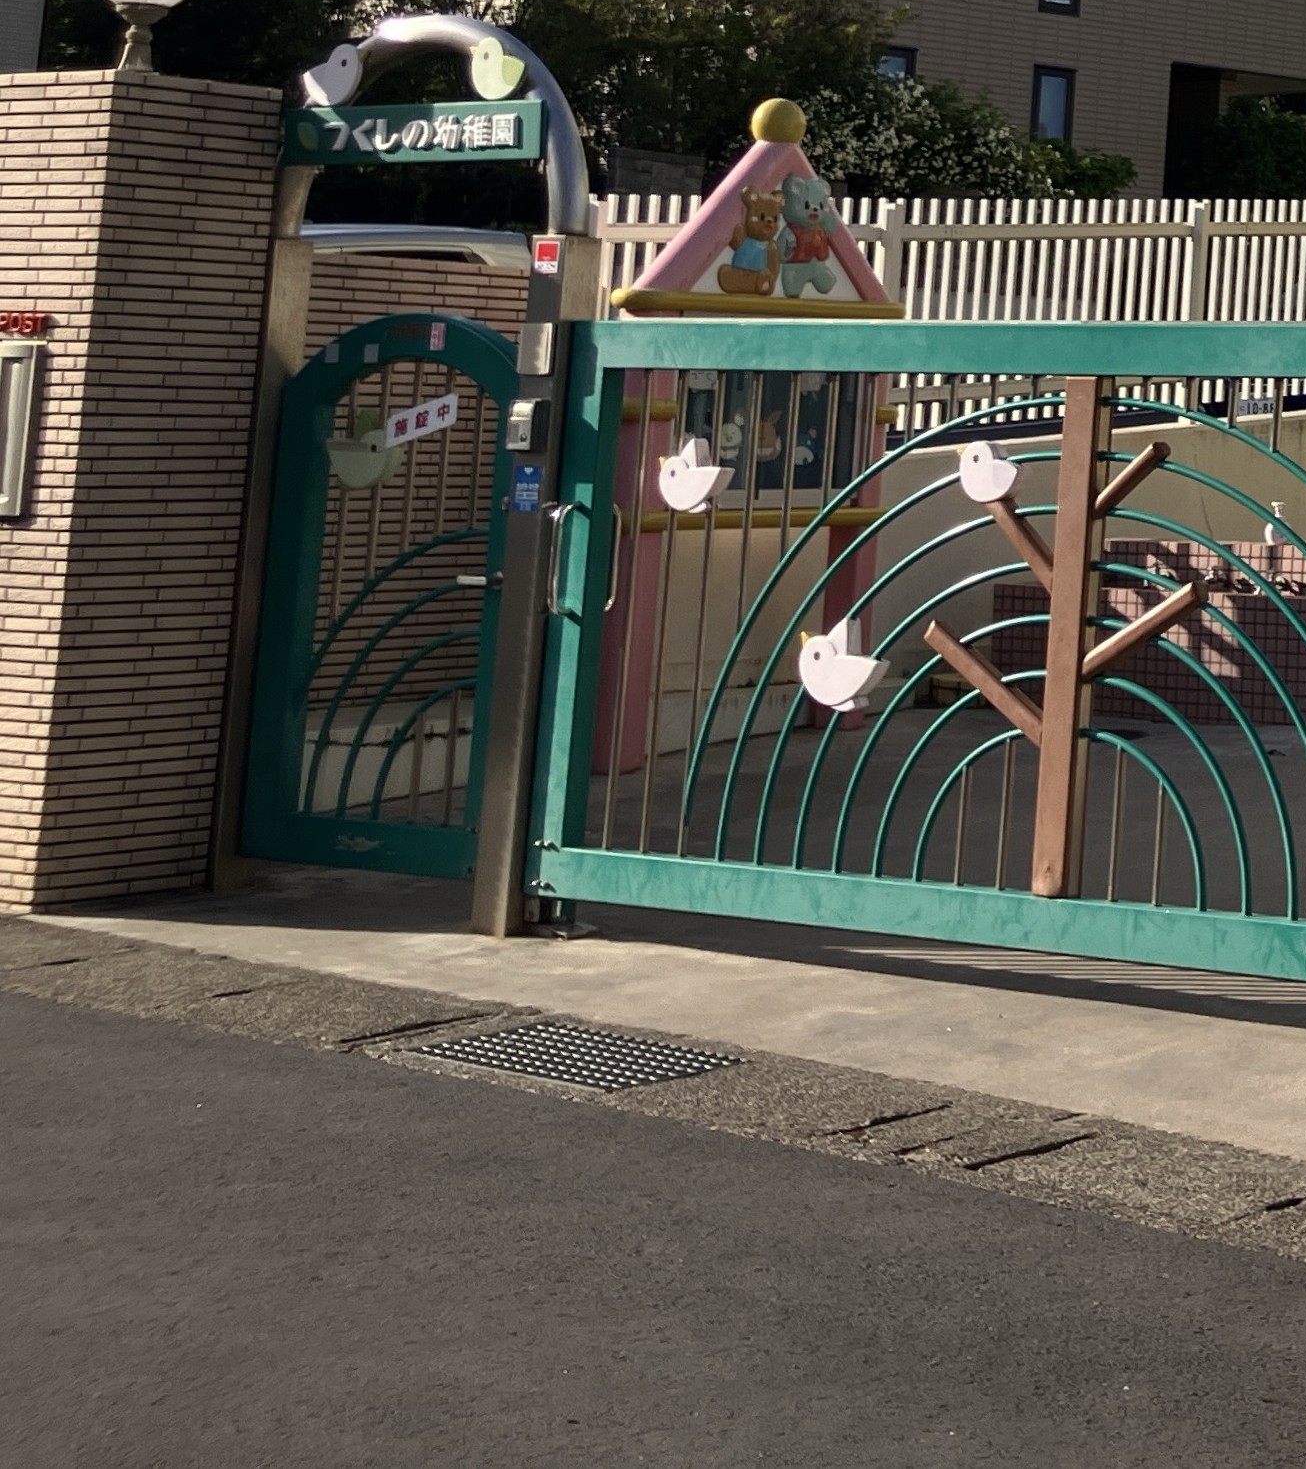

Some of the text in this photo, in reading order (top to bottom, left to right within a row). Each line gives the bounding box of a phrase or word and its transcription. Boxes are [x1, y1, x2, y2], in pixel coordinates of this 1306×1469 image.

[324, 112, 521, 152] つくしの幼稚園
[0, 312, 49, 334] POST
[394, 402, 451, 438] 施錠中
